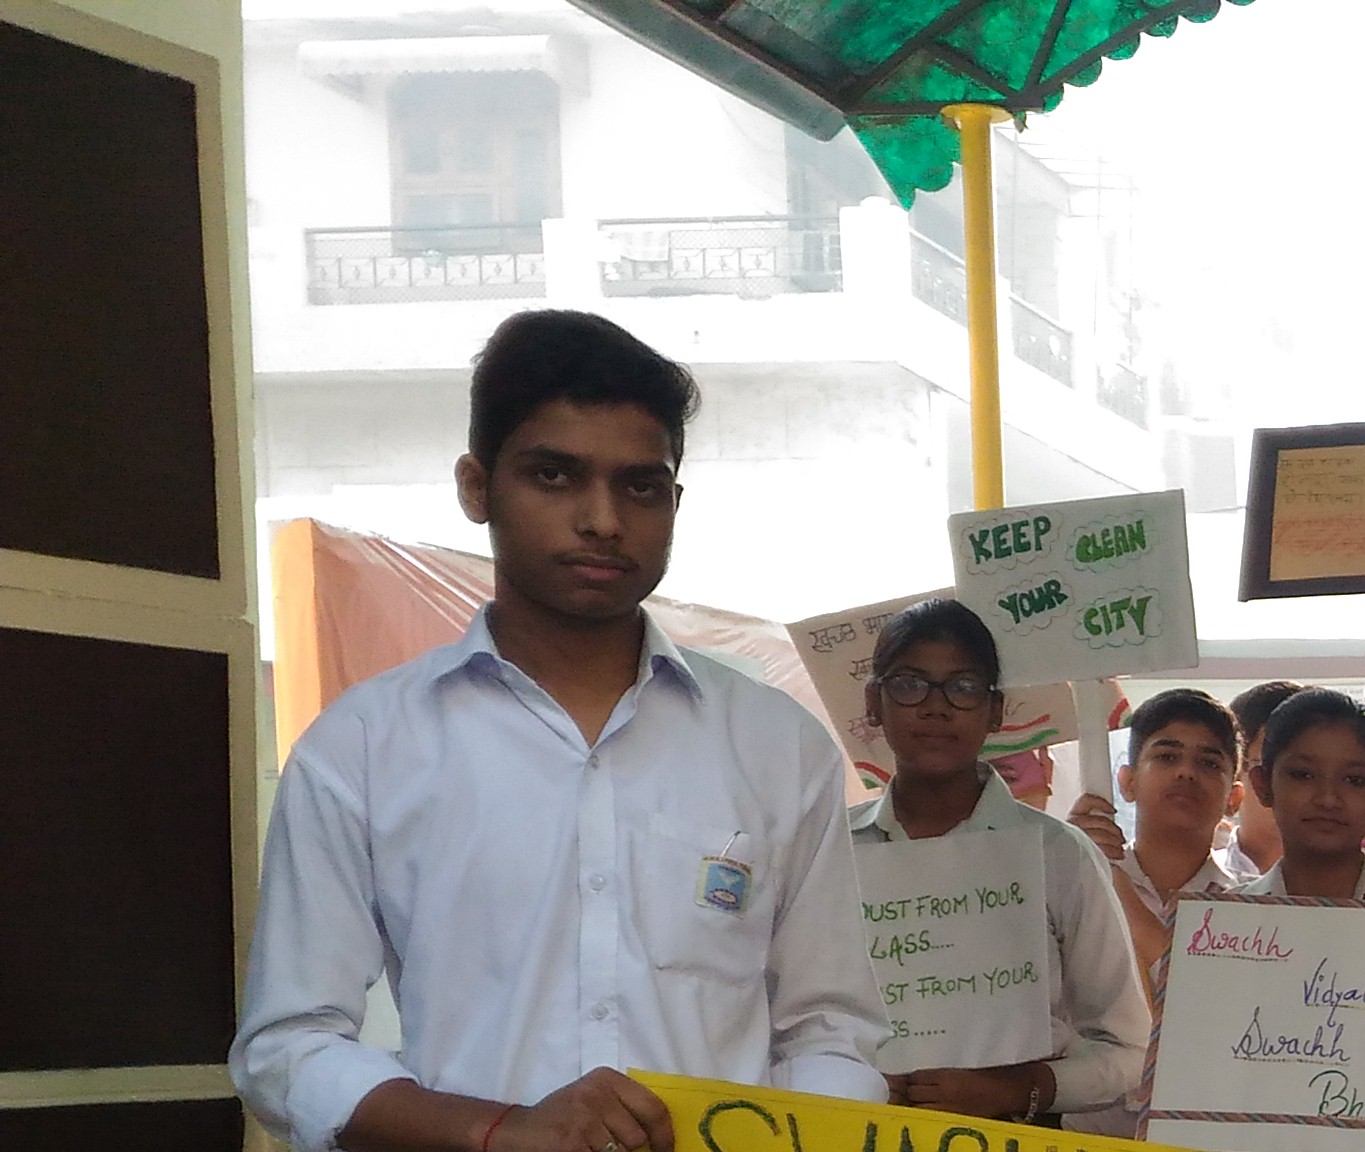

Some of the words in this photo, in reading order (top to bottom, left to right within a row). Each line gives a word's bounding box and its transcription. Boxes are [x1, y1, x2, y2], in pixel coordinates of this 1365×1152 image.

[968, 515, 1052, 564] KEEP
[1075, 519, 1147, 563] CLEAN
[998, 579, 1069, 624] YOUR
[1082, 595, 1153, 636] CITY
[916, 895, 969, 918] FROM
[975, 882, 1024, 913] YOUR
[1188, 907, 1293, 957] Swachh
[915, 976, 976, 999] FROM
[983, 961, 1038, 995] YOUR
[1231, 1006, 1350, 1062] Swachh
